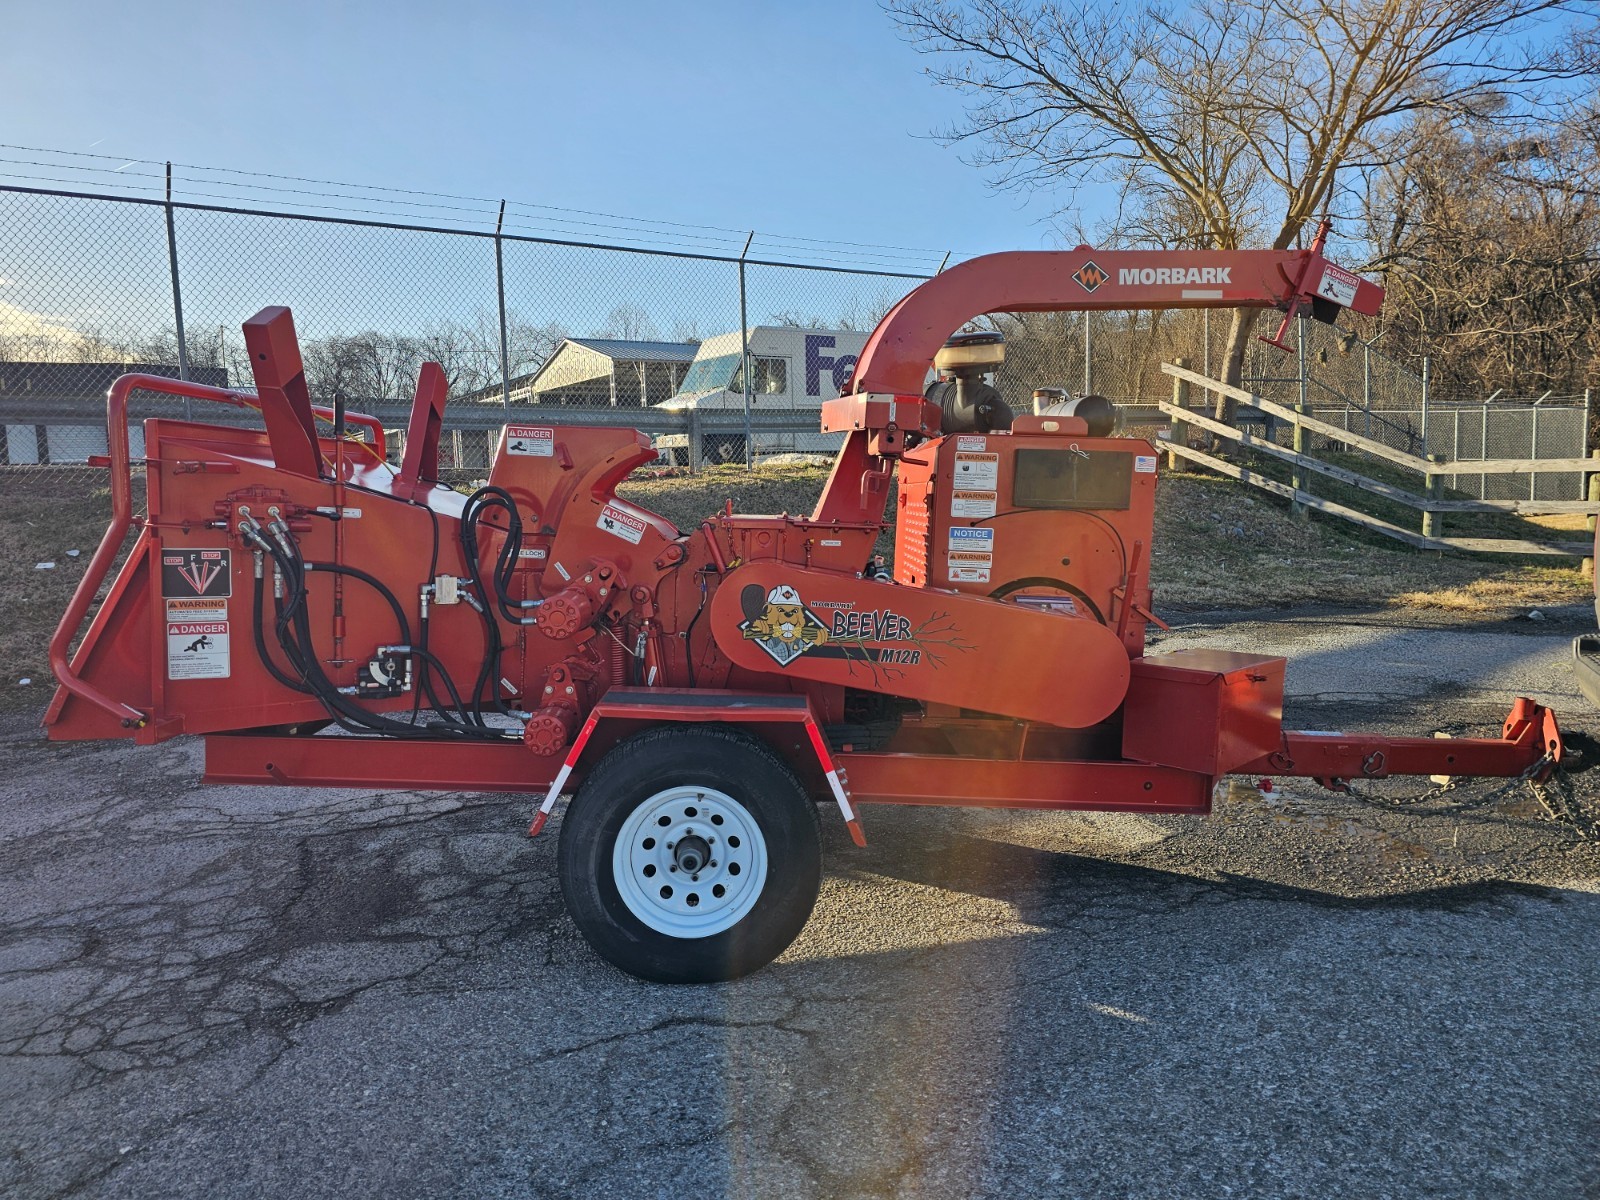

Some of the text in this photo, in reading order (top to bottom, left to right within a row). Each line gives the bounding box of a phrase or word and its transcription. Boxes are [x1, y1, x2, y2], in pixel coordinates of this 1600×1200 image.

[1118, 267, 1232, 285] MORBARK
[1331, 270, 1358, 286] DANGER
[517, 430, 551, 438] DANGER
[611, 511, 643, 531] DANGER
[953, 530, 989, 538] NOTICE
[178, 600, 225, 608] WARNING
[181, 624, 226, 634] DANGER
[831, 609, 913, 642] BEEVER
[880, 648, 922, 665] M12R
